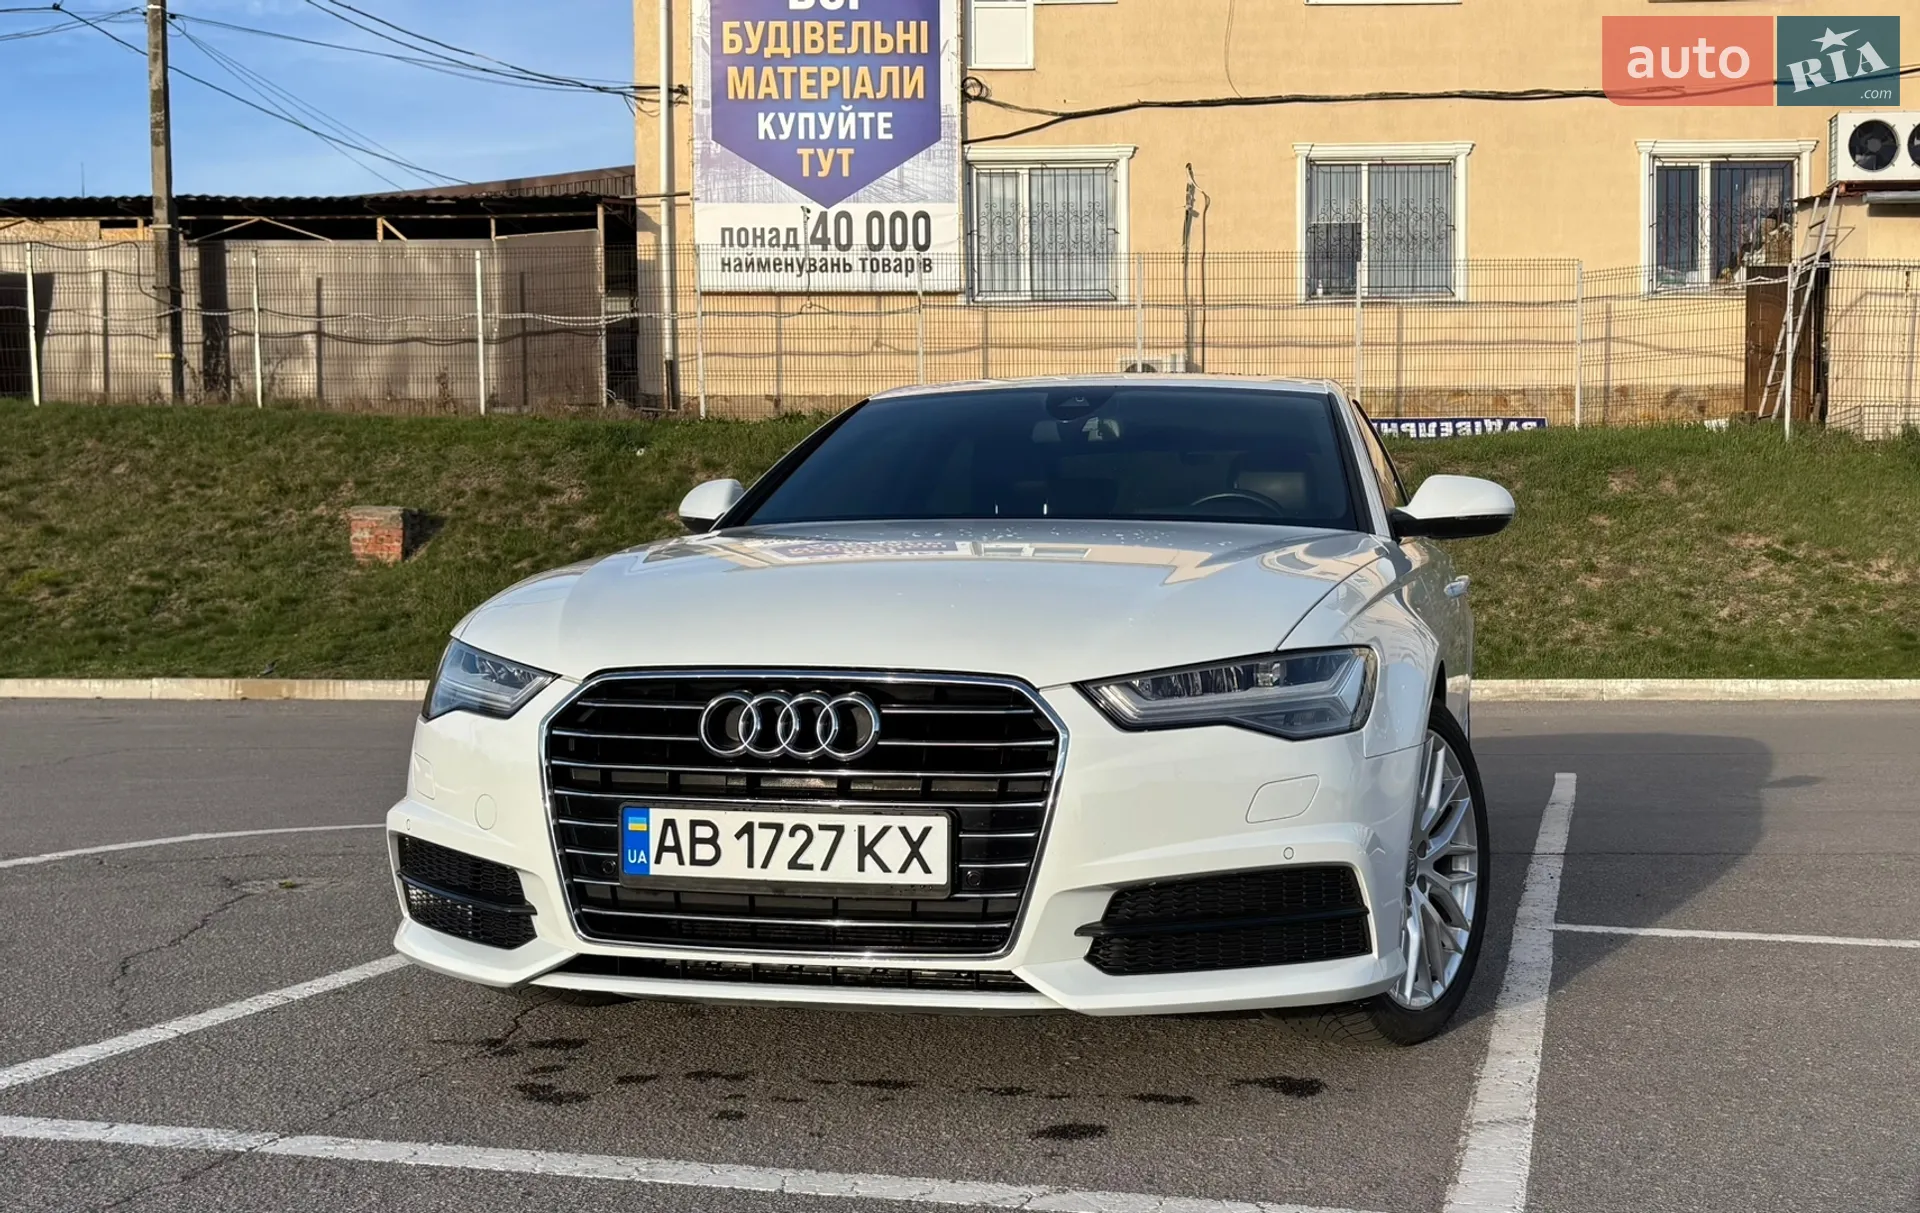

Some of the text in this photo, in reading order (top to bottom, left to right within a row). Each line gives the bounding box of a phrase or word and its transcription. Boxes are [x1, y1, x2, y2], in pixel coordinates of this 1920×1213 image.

[721, 20, 929, 58] БУДІВЕЛЬНІ
[726, 65, 925, 101] МАТЕРІАЛИ
[757, 105, 894, 140] КУПУЙТЕ
[796, 148, 855, 178] ТУТ
[720, 210, 932, 253] понад 40 000
[720, 252, 933, 278] найменувань товарв
[628, 849, 648, 864] UA
[654, 818, 933, 875] AB 1727 KX
